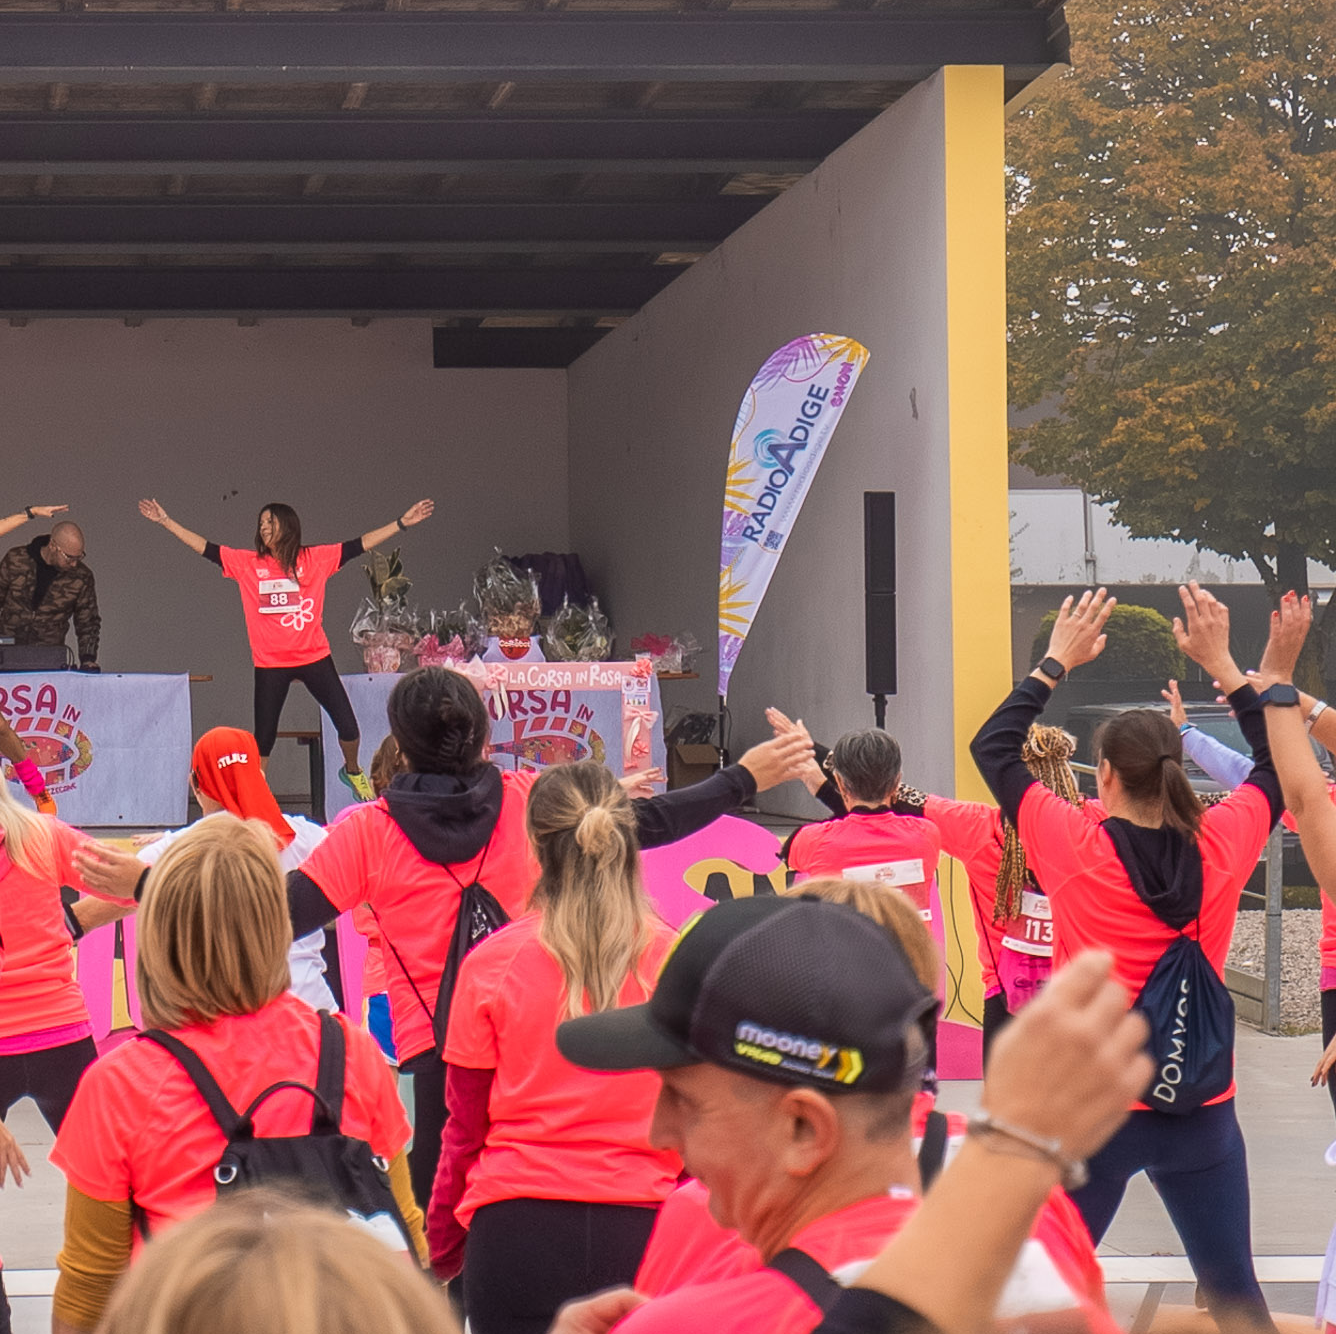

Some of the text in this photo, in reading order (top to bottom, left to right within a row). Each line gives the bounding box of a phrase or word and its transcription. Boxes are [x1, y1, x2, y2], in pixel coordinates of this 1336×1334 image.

[742, 383, 830, 543] RADIOADIGE
[270, 593, 289, 606] 88
[508, 670, 526, 684] LA
[575, 670, 588, 685] IN
[63, 704, 82, 723] IN
[575, 704, 595, 723] IN
[1025, 918, 1054, 943] 113
[735, 1022, 839, 1069] mooney
